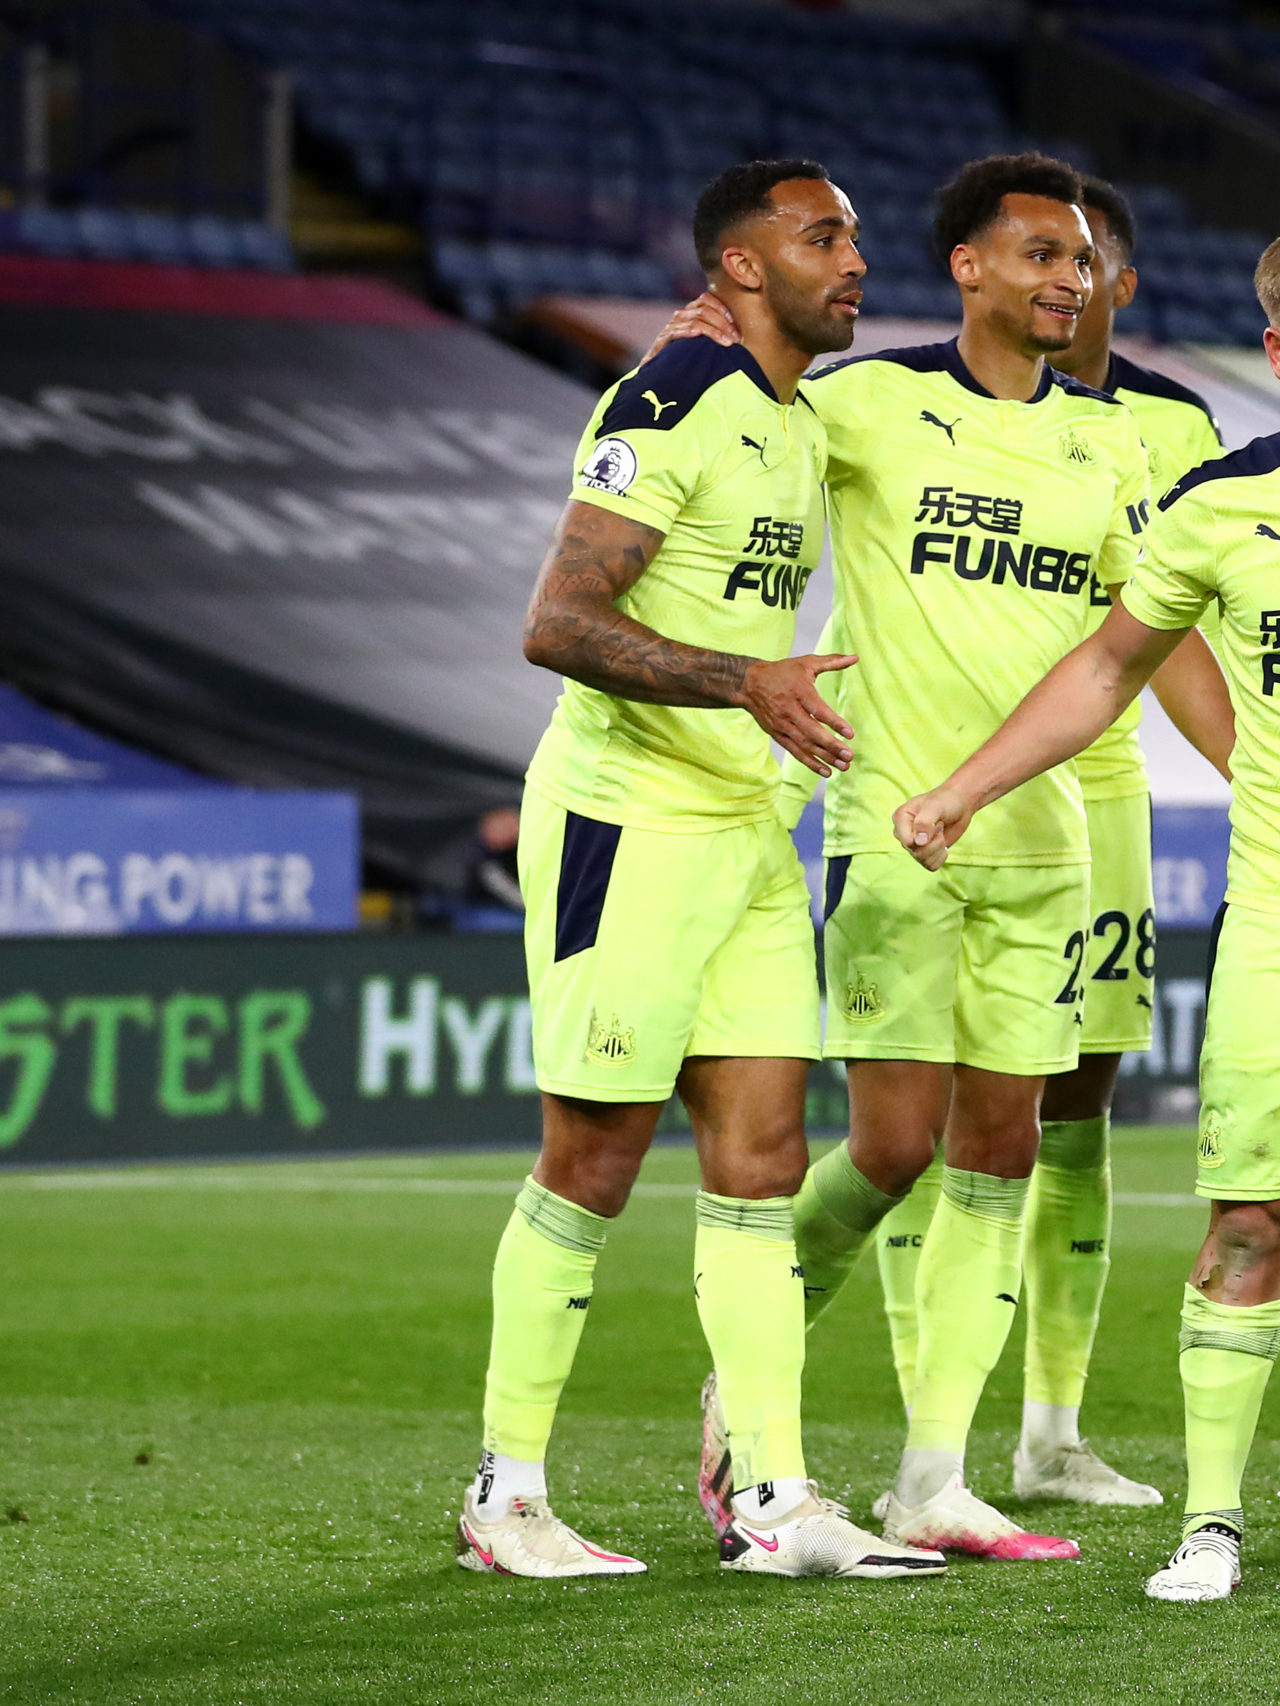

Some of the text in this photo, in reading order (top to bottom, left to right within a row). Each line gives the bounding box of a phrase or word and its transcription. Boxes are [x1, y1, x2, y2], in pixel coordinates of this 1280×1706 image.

[743, 516, 804, 558] 乐天堂
[914, 486, 1023, 535] 乐天堂
[910, 532, 1092, 595] FUN88
[121, 852, 314, 924] POWER
[1054, 930, 1085, 1004] 2
[1092, 908, 1155, 980] 28
[0, 989, 325, 1149] STER
